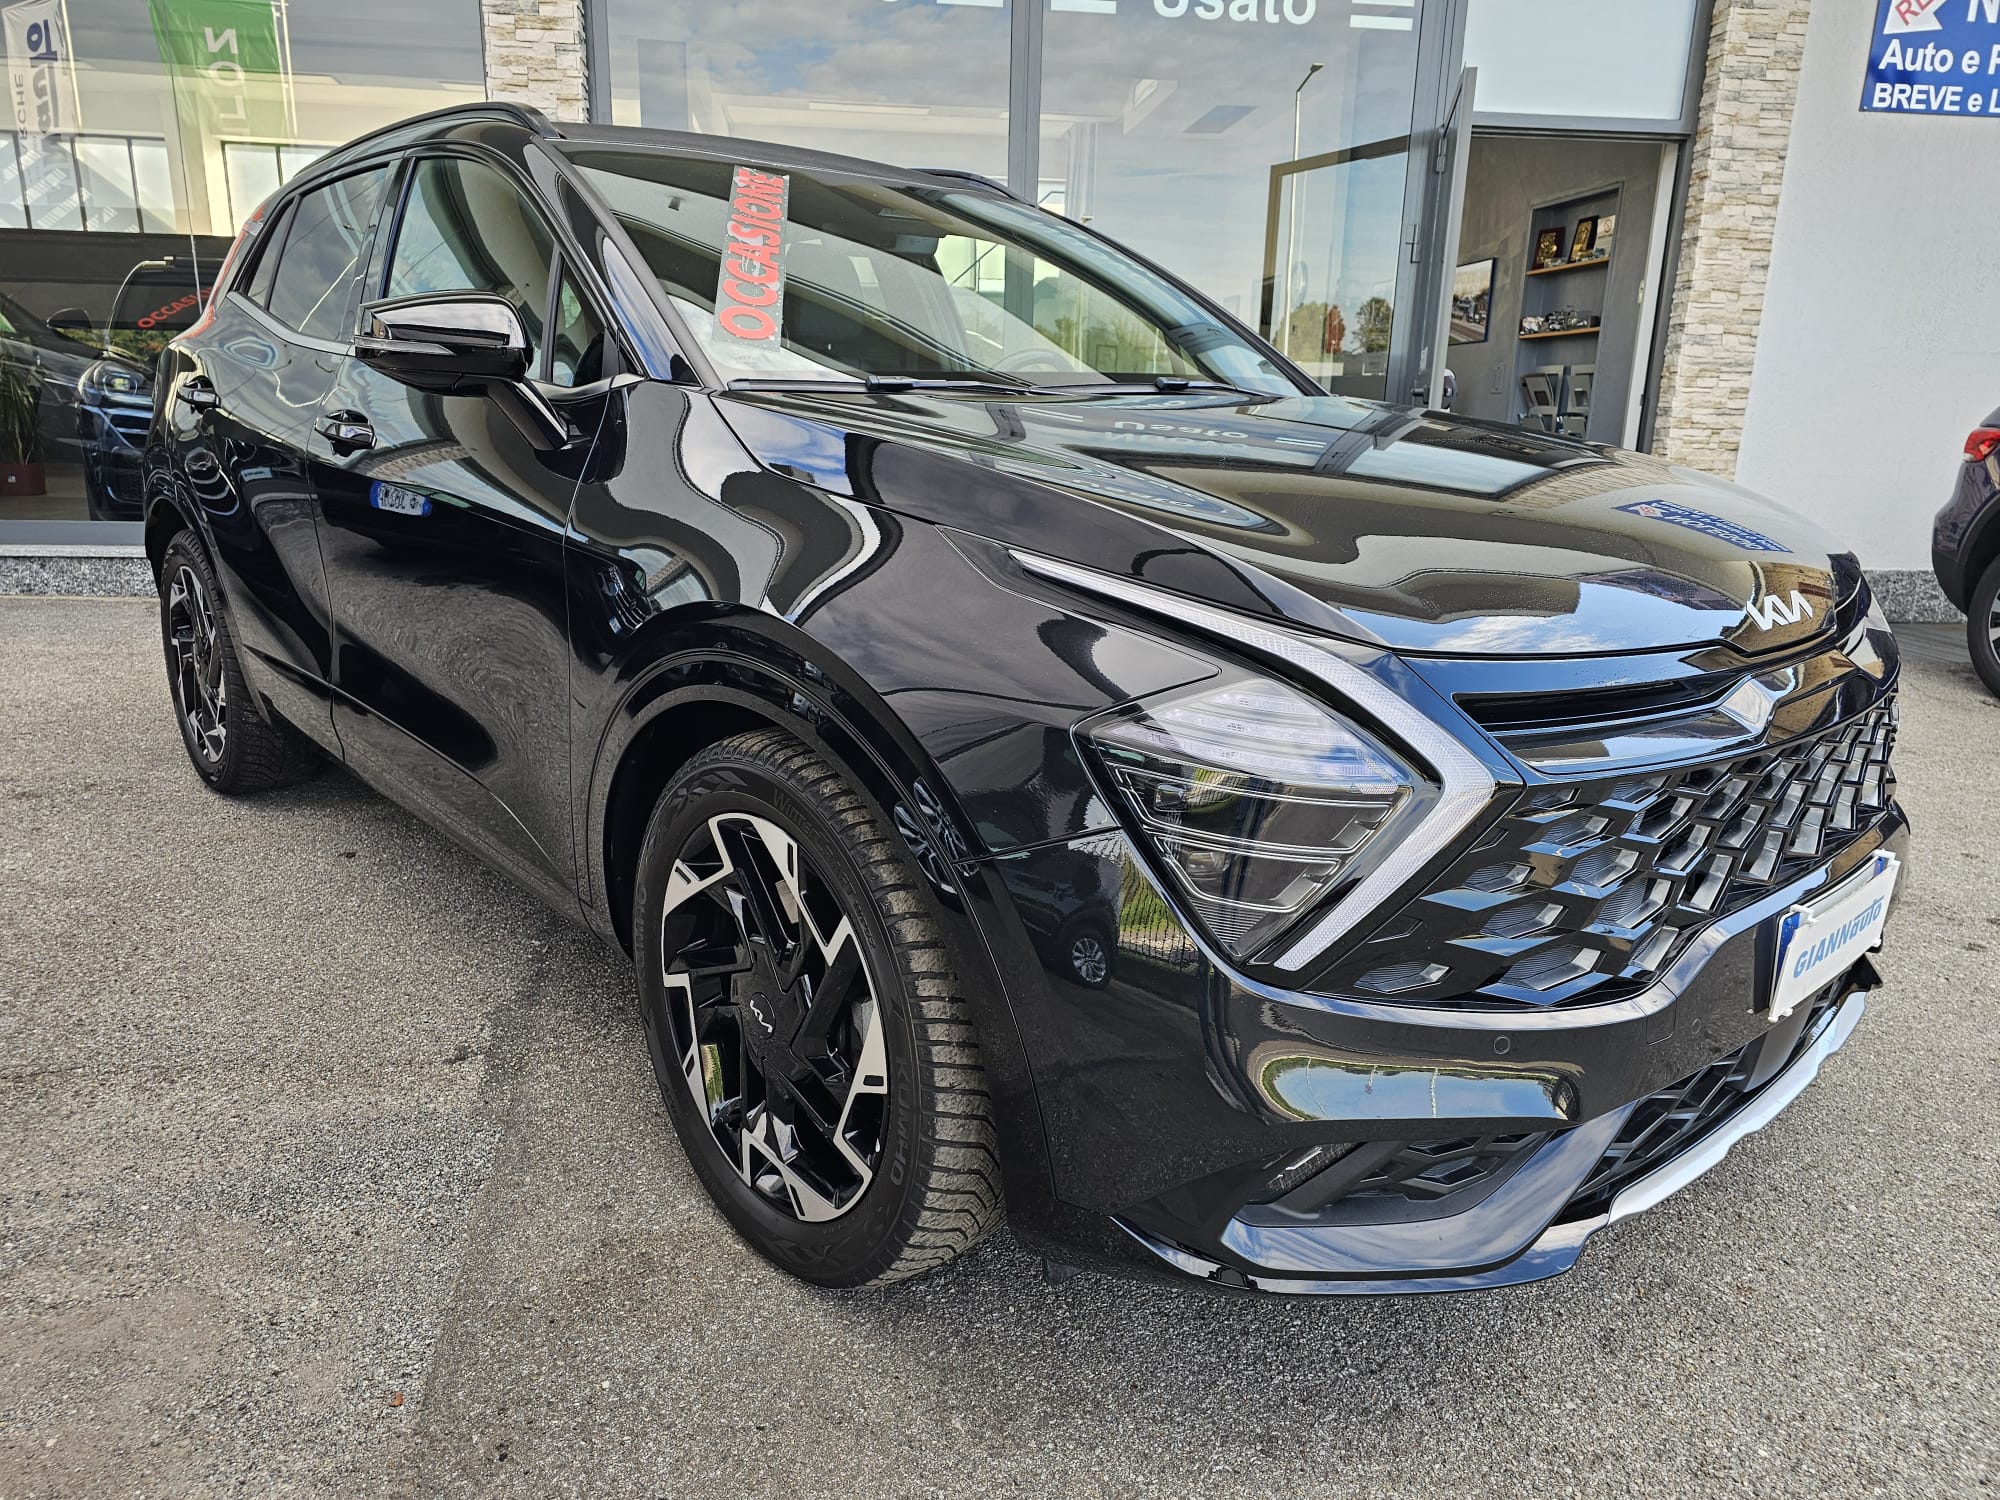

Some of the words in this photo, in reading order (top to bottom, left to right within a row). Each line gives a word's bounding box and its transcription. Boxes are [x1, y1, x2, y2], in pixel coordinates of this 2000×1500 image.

[1878, 38, 1954, 73] Auto
[1961, 50, 1980, 74] e
[1872, 82, 1963, 111] BREVE
[1967, 93, 1983, 112] e
[719, 167, 785, 340] OCCASIONE
